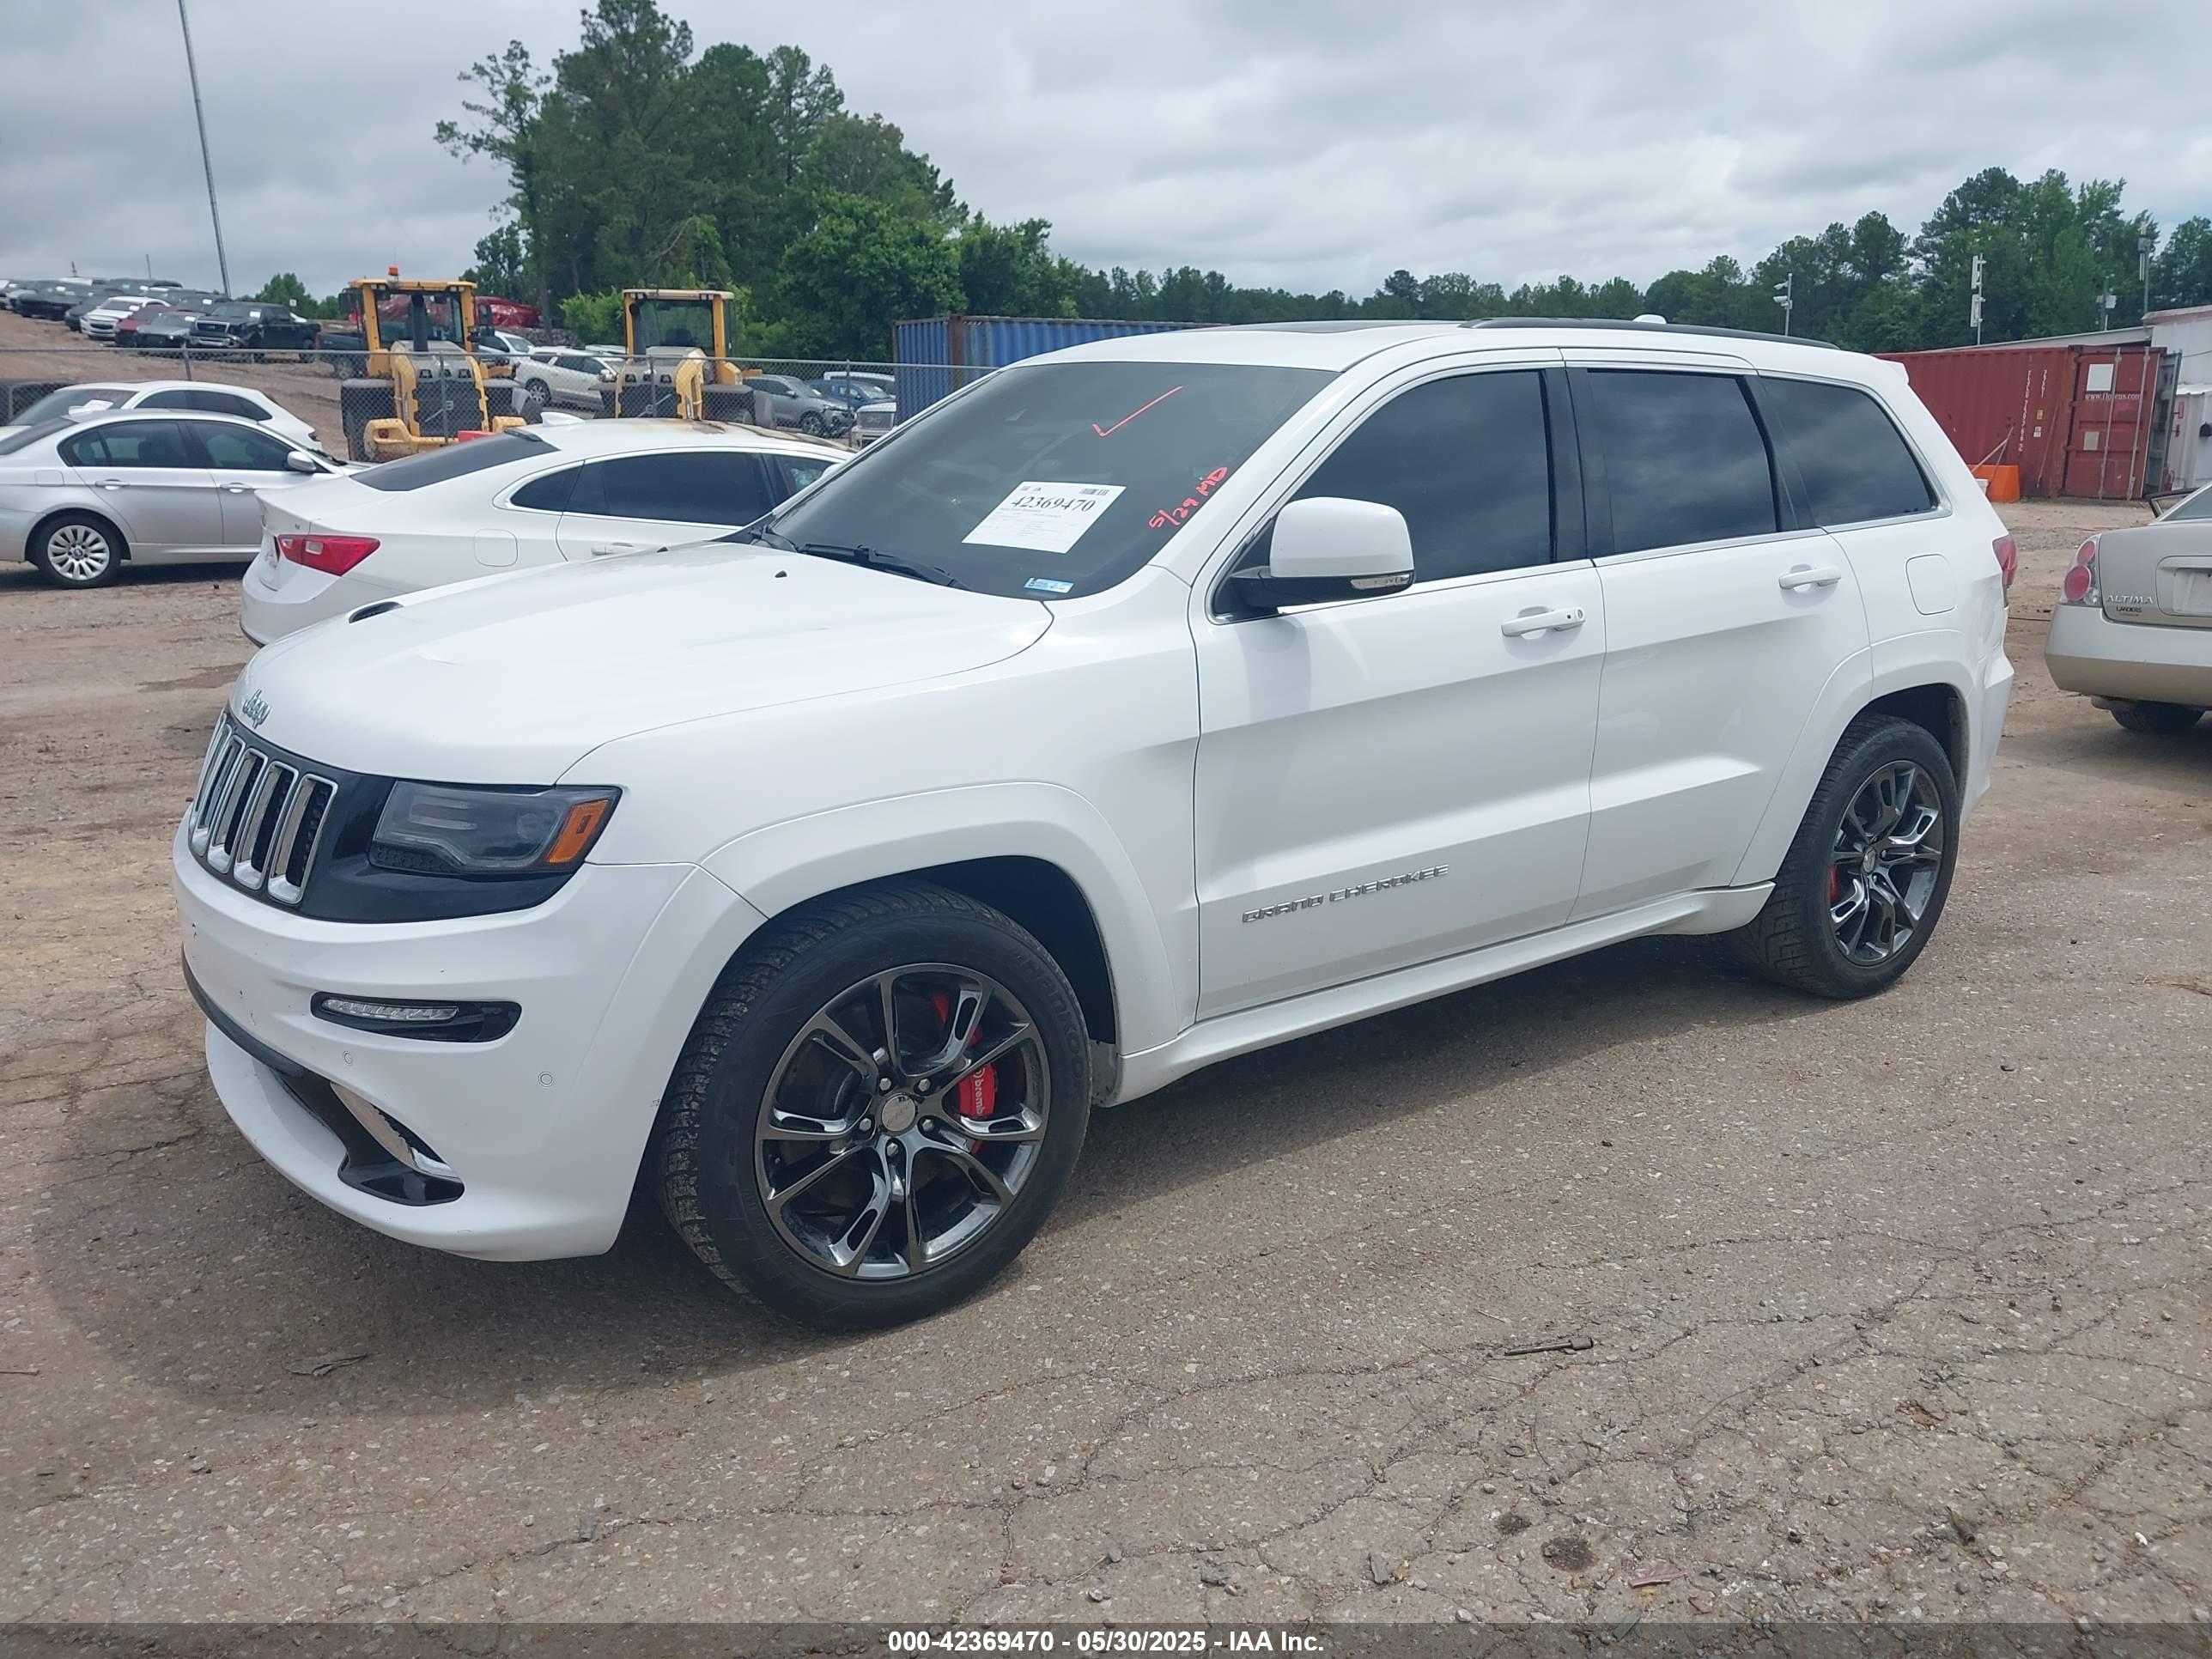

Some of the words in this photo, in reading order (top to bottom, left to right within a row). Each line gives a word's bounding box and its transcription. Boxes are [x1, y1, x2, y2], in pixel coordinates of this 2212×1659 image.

[1010, 495, 1097, 513] 42369470
[2106, 594, 2153, 605] ALTIMA
[1242, 894, 1323, 923] GRAND
[1329, 864, 1449, 902] CHEROKEE
